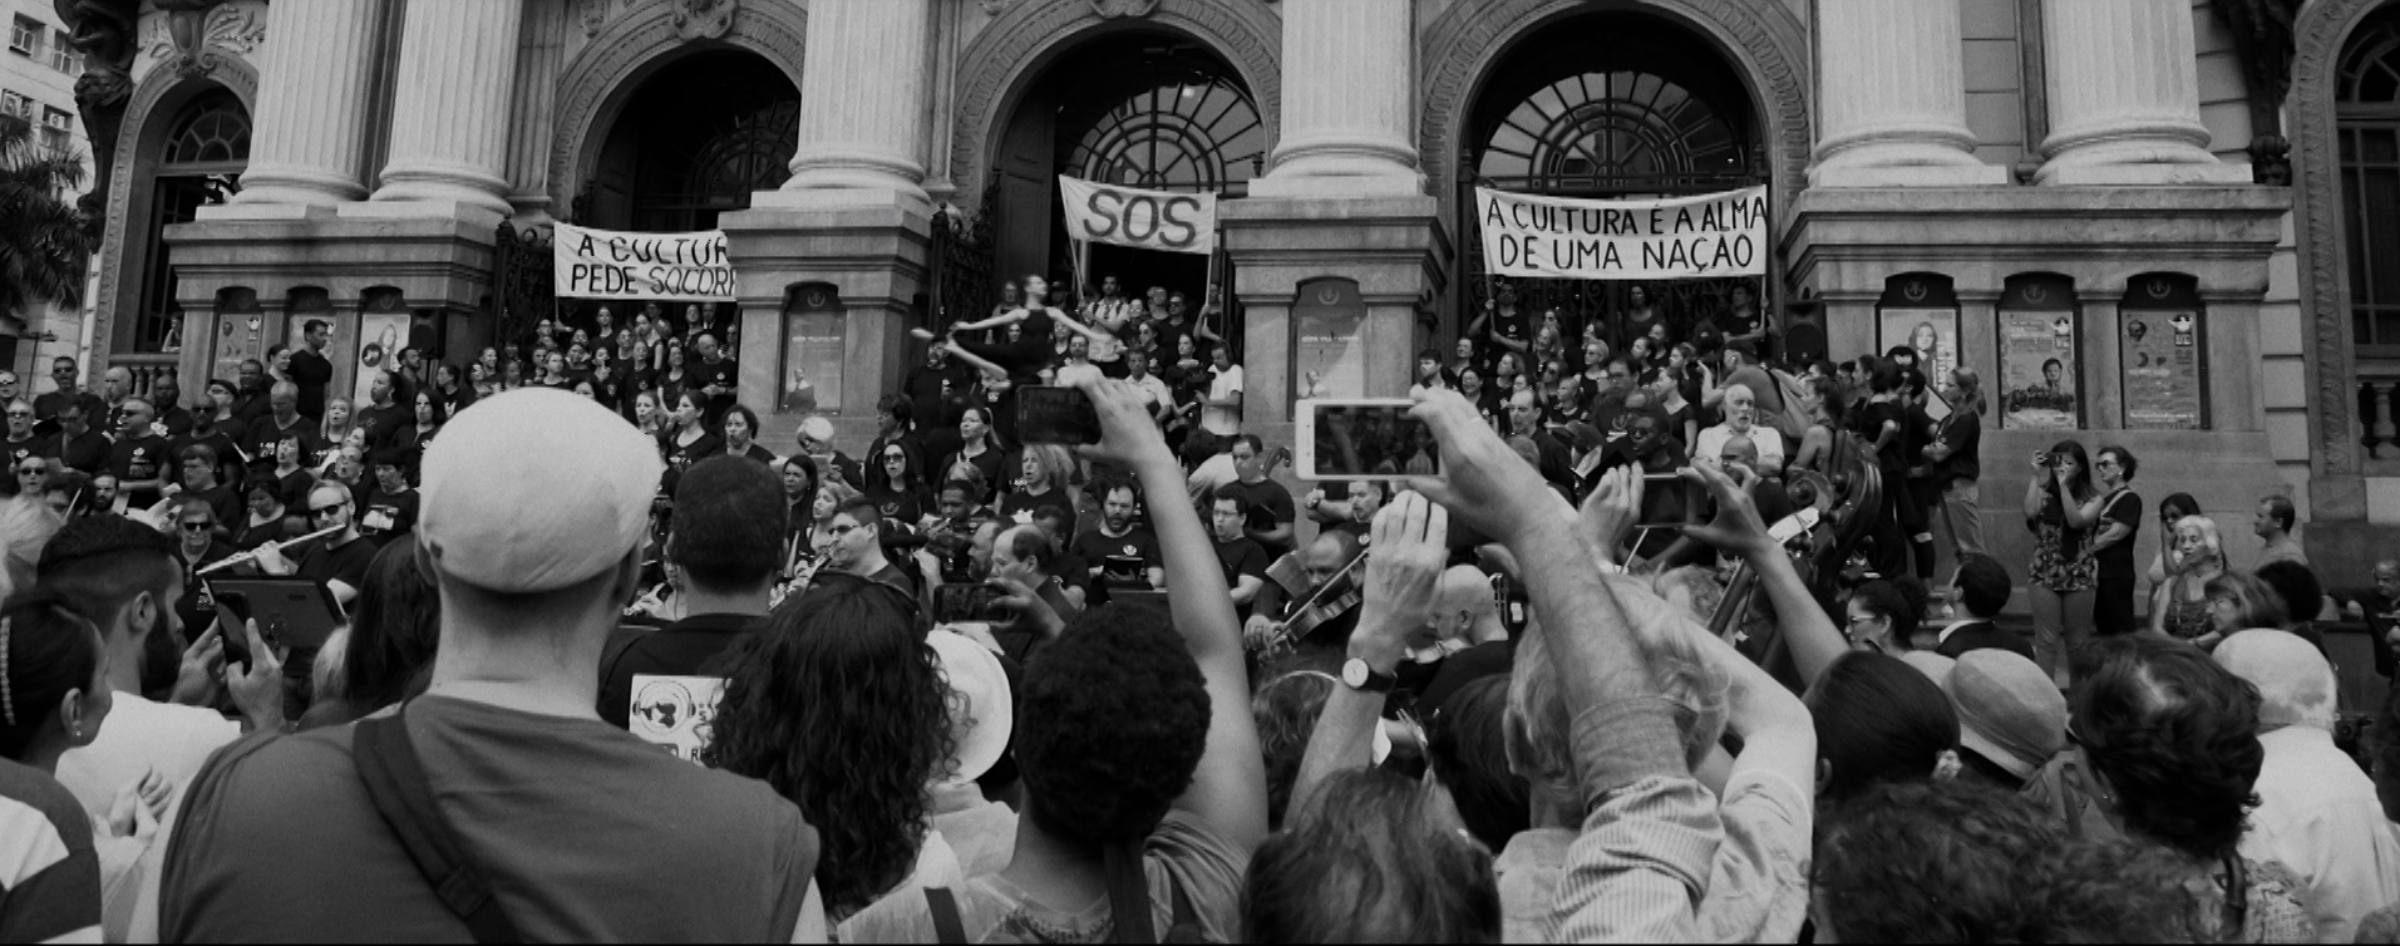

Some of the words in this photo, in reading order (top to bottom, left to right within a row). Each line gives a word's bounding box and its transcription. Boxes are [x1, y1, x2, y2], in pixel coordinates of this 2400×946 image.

[1083, 188, 1200, 247] SOS
[1487, 197, 1506, 228] A
[1512, 202, 1638, 234] CULTURA
[1674, 206, 1695, 234] A
[1701, 196, 1767, 232] ALMA
[578, 234, 595, 257] A
[1500, 233, 1540, 268] DE
[1553, 238, 1623, 270] UMA
[571, 263, 640, 295] PEDE
